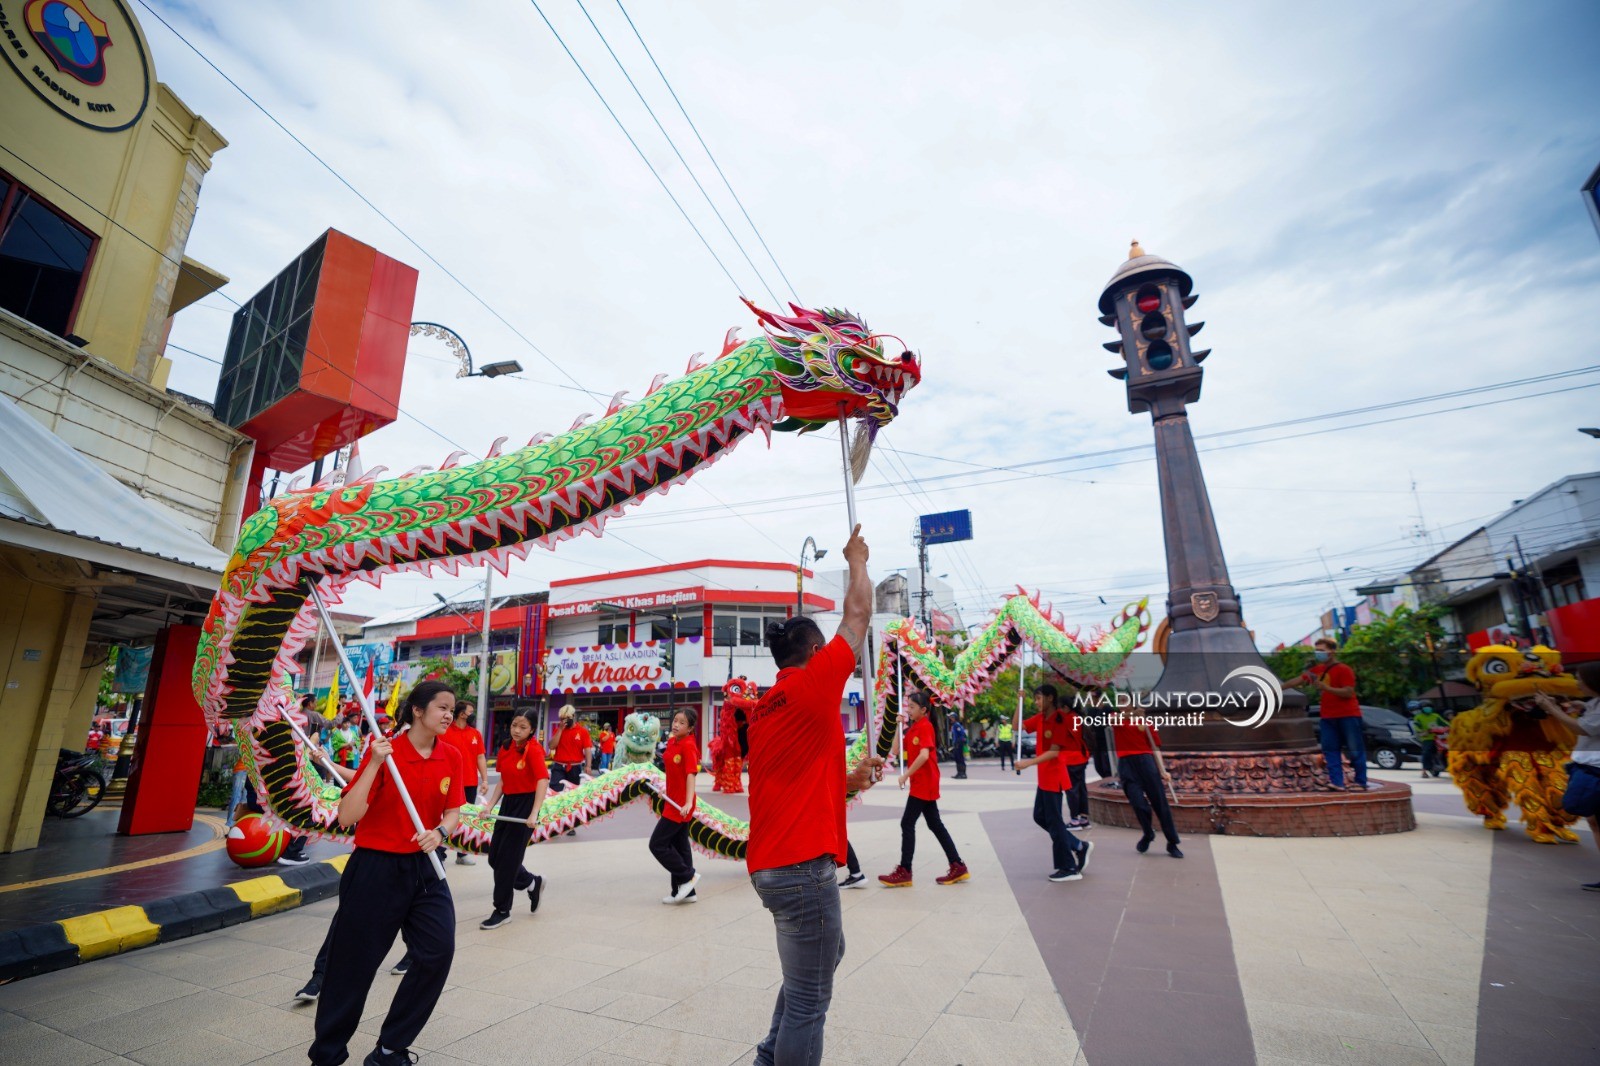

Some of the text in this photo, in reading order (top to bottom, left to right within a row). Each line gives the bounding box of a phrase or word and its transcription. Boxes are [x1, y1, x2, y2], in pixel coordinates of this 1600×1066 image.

[0, 3, 116, 113] OLRES MADIUN KOTA
[549, 607, 576, 618] Pusat
[626, 596, 654, 609] Khas
[656, 591, 697, 606] Madiun
[582, 649, 658, 662] BREM ASLI MADIUN
[571, 661, 663, 685] Mirasa
